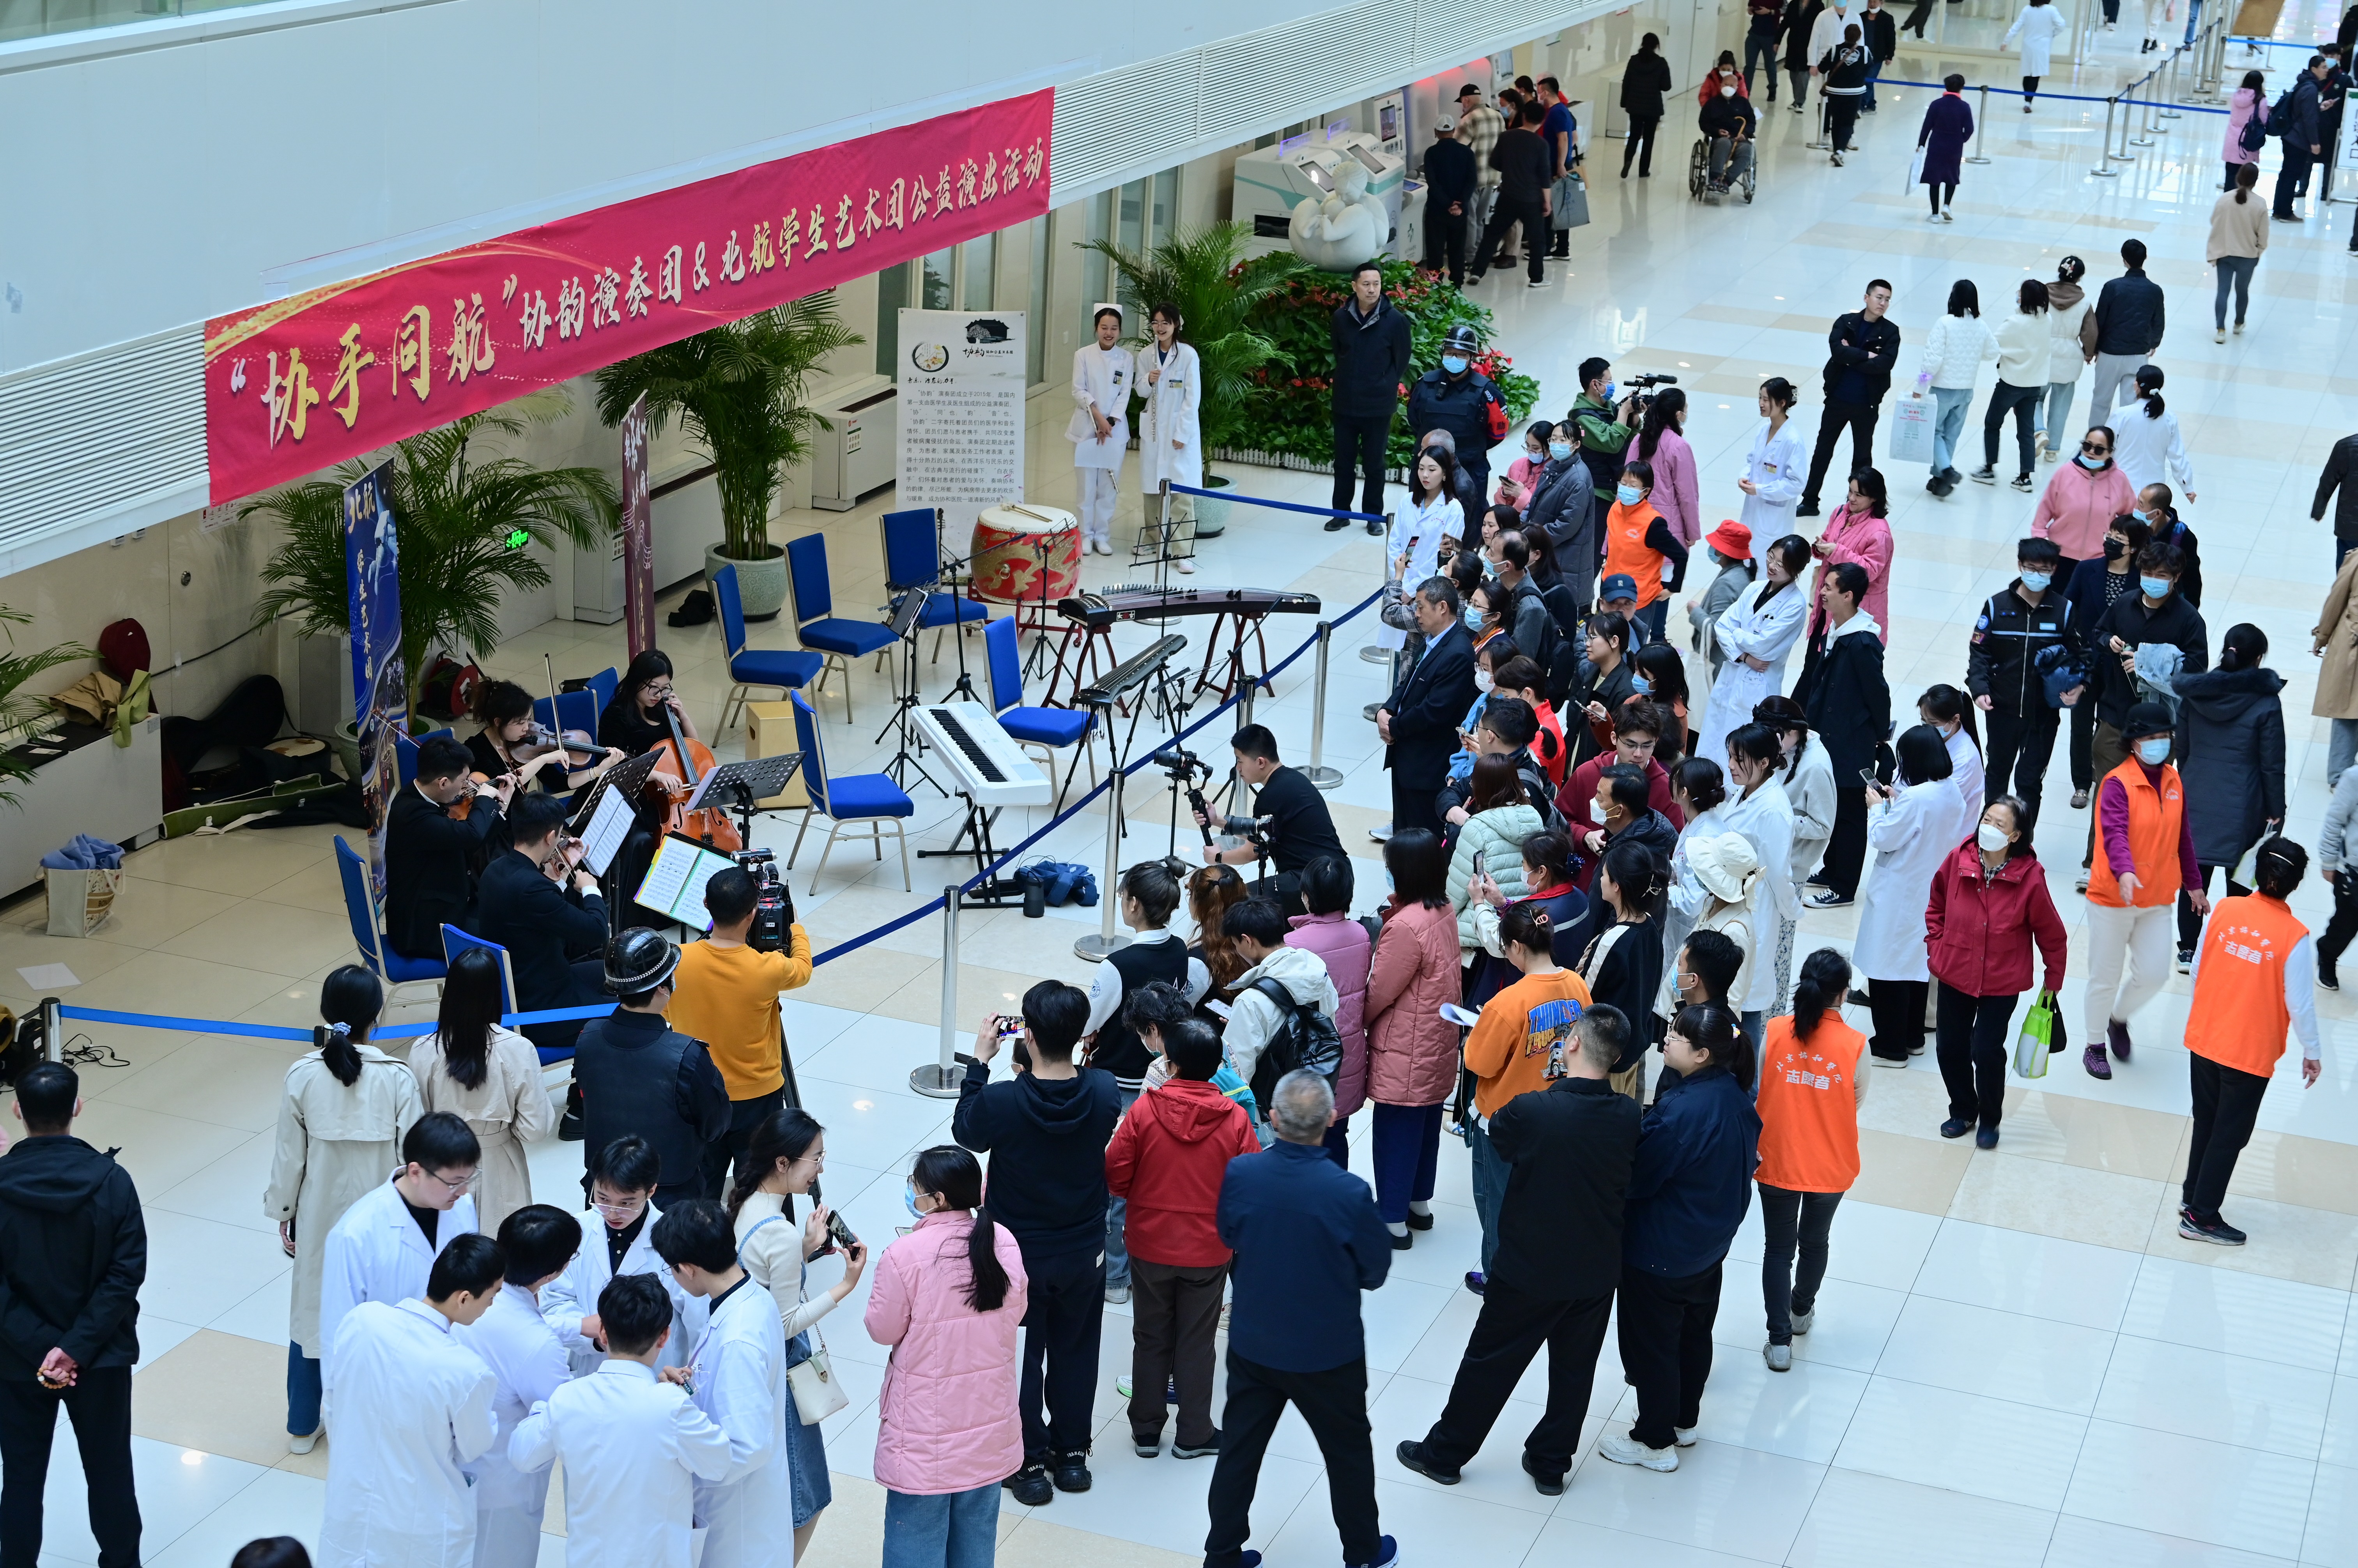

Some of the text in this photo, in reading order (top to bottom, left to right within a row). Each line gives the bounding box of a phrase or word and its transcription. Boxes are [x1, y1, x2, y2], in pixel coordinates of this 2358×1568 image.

[348, 481, 375, 534] 北航
[2224, 940, 2262, 965] 志愿者
[1528, 999, 1583, 1034] THUNDER
[1525, 1027, 1556, 1057] TRUCK
[1786, 1069, 1830, 1090] 志愿者
